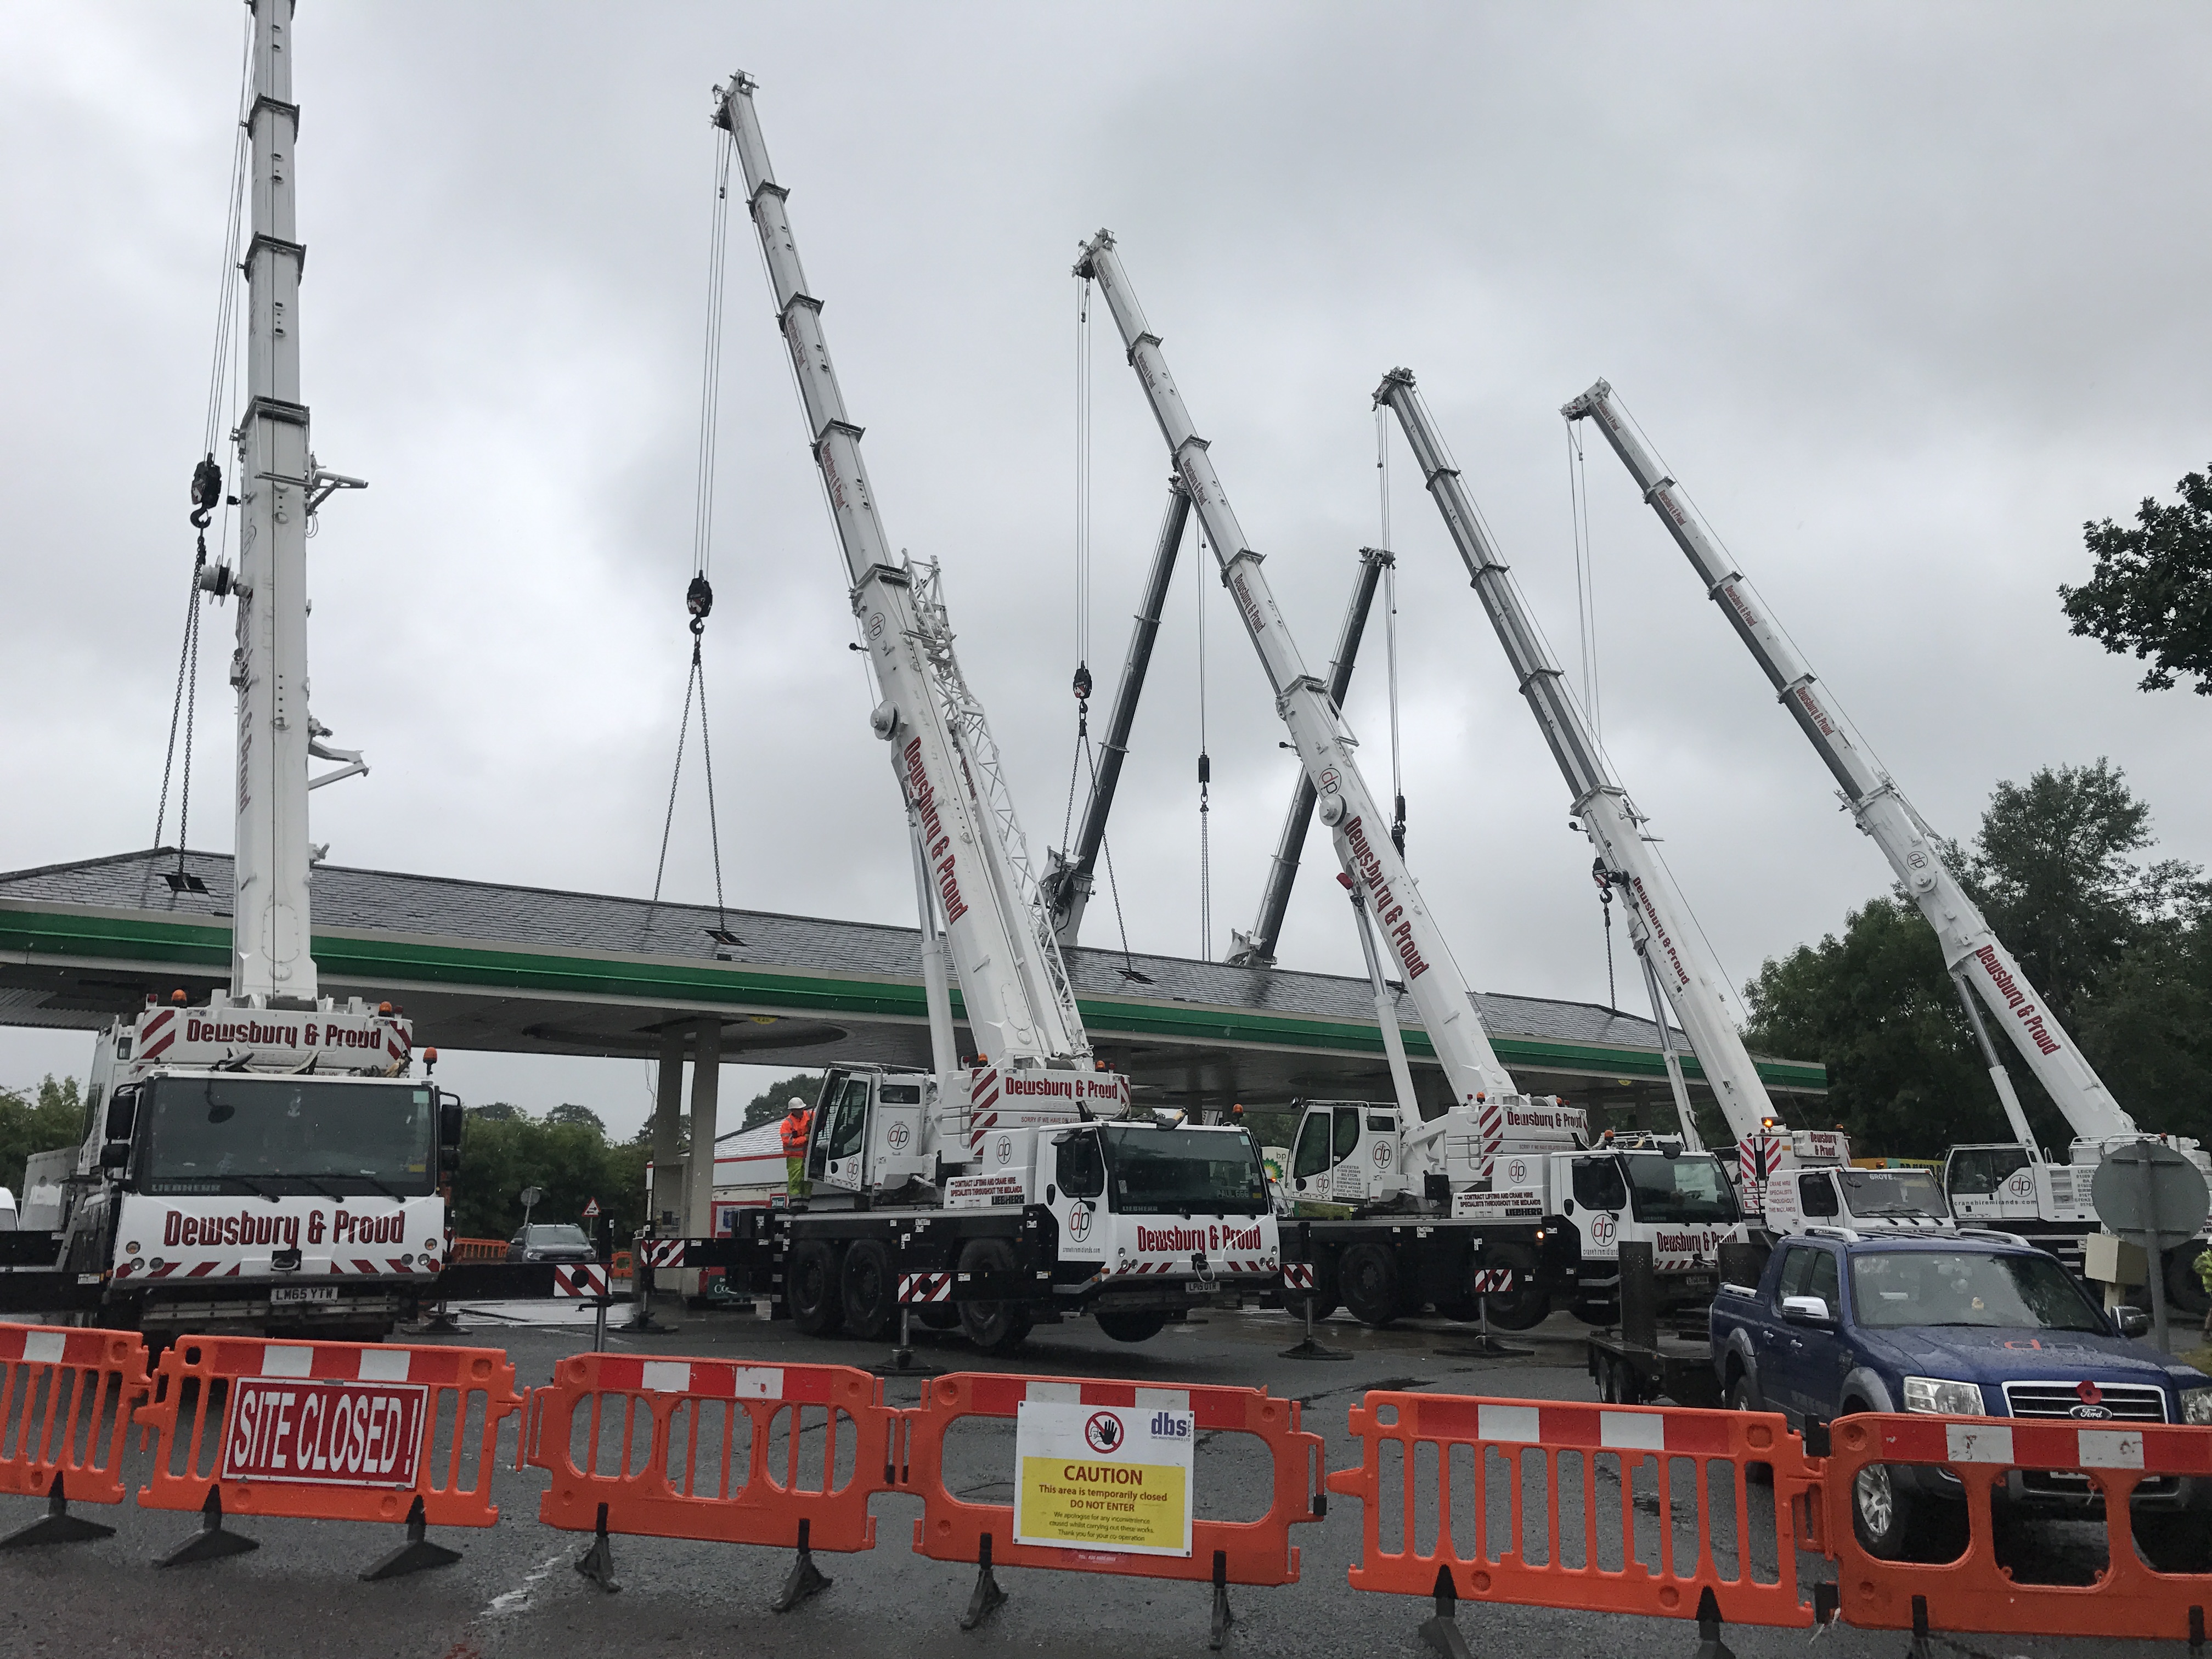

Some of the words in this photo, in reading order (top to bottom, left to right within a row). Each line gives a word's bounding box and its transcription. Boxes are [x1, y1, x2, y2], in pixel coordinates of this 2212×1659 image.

[1183, 458, 1198, 489] Dewsbury
[1196, 487, 1207, 506] Proud
[1234, 573, 1253, 611] Dewsbury
[1247, 605, 1256, 616] &
[1725, 585, 1742, 611] Dewsbury
[1743, 609, 1757, 627] Proud
[1250, 610, 1266, 634] Proud
[1796, 686, 1819, 716] Dewsbury
[1817, 718, 1835, 736] Proud
[904, 736, 939, 847] Dewsbury
[932, 836, 950, 861] &
[1344, 816, 1393, 913] Dewsbury
[936, 854, 968, 926] Proud
[1385, 905, 1403, 926] &
[1633, 877, 1665, 939] Dewsbury
[1662, 937, 1671, 948] &
[1667, 947, 1690, 985] Proud
[1392, 921, 1429, 980] Proud
[1976, 944, 2025, 1009] Dewsbury
[2017, 1004, 2035, 1018] &
[187, 1019, 297, 1048] Dewsbury
[304, 1023, 320, 1046] &
[325, 1024, 381, 1049] Proud
[2024, 1015, 2061, 1056] Proud
[1005, 1077, 1071, 1099] Dewsbury
[1076, 1080, 1085, 1097] &
[1088, 1080, 1117, 1099] Proud
[1507, 1111, 1554, 1129] Dewsbury
[1556, 1113, 1562, 1127] &
[1564, 1114, 1582, 1128] Proud
[889, 1126, 908, 1147] dp
[1810, 1131, 1837, 1146] Dewsbury
[998, 1138, 1011, 1161] dp
[1375, 1144, 1390, 1166] dp
[1814, 1144, 1819, 1156] &
[1820, 1145, 1836, 1156] Proud
[848, 1159, 858, 1179] dp
[1510, 1161, 1525, 1181] dp
[1217, 1189, 1234, 1198] PAUL
[1318, 1175, 1328, 1192] dp
[2011, 1177, 2030, 1195] dp
[991, 1194, 1025, 1205] LIEBHERR
[1071, 1205, 1090, 1238] dp
[1505, 1208, 1543, 1216] LIEBHERR
[163, 1210, 300, 1249] Dewsbury
[307, 1210, 326, 1244] &
[333, 1210, 405, 1244] Proud
[1137, 1225, 1205, 1254] Dewsbury
[1209, 1224, 1219, 1250] &
[1222, 1224, 1261, 1250] Proud
[1594, 1217, 1614, 1243] dp
[1656, 1231, 1701, 1254] Dewsbury
[1702, 1231, 1711, 1251] &
[276, 1288, 306, 1301] LM65
[310, 1288, 334, 1300] YTW
[1152, 1412, 1187, 1436] dbs
[2080, 1408, 2102, 1419] Ford
[234, 1390, 296, 1468] SITE
[297, 1392, 402, 1474] CLOSED
[404, 1398, 419, 1475] !
[1064, 1465, 1142, 1486] CAUTION
[1039, 1485, 1057, 1493] This
[1079, 1487, 1085, 1496] is
[1088, 1489, 1138, 1501] temporarily
[1140, 1492, 1167, 1501] closed
[1086, 1501, 1105, 1510] NOT
[1107, 1502, 1135, 1512] ENTER
[1064, 1513, 1090, 1521] apologise
[1111, 1516, 1150, 1524] inconvenience
[1076, 1531, 1086, 1539] you
